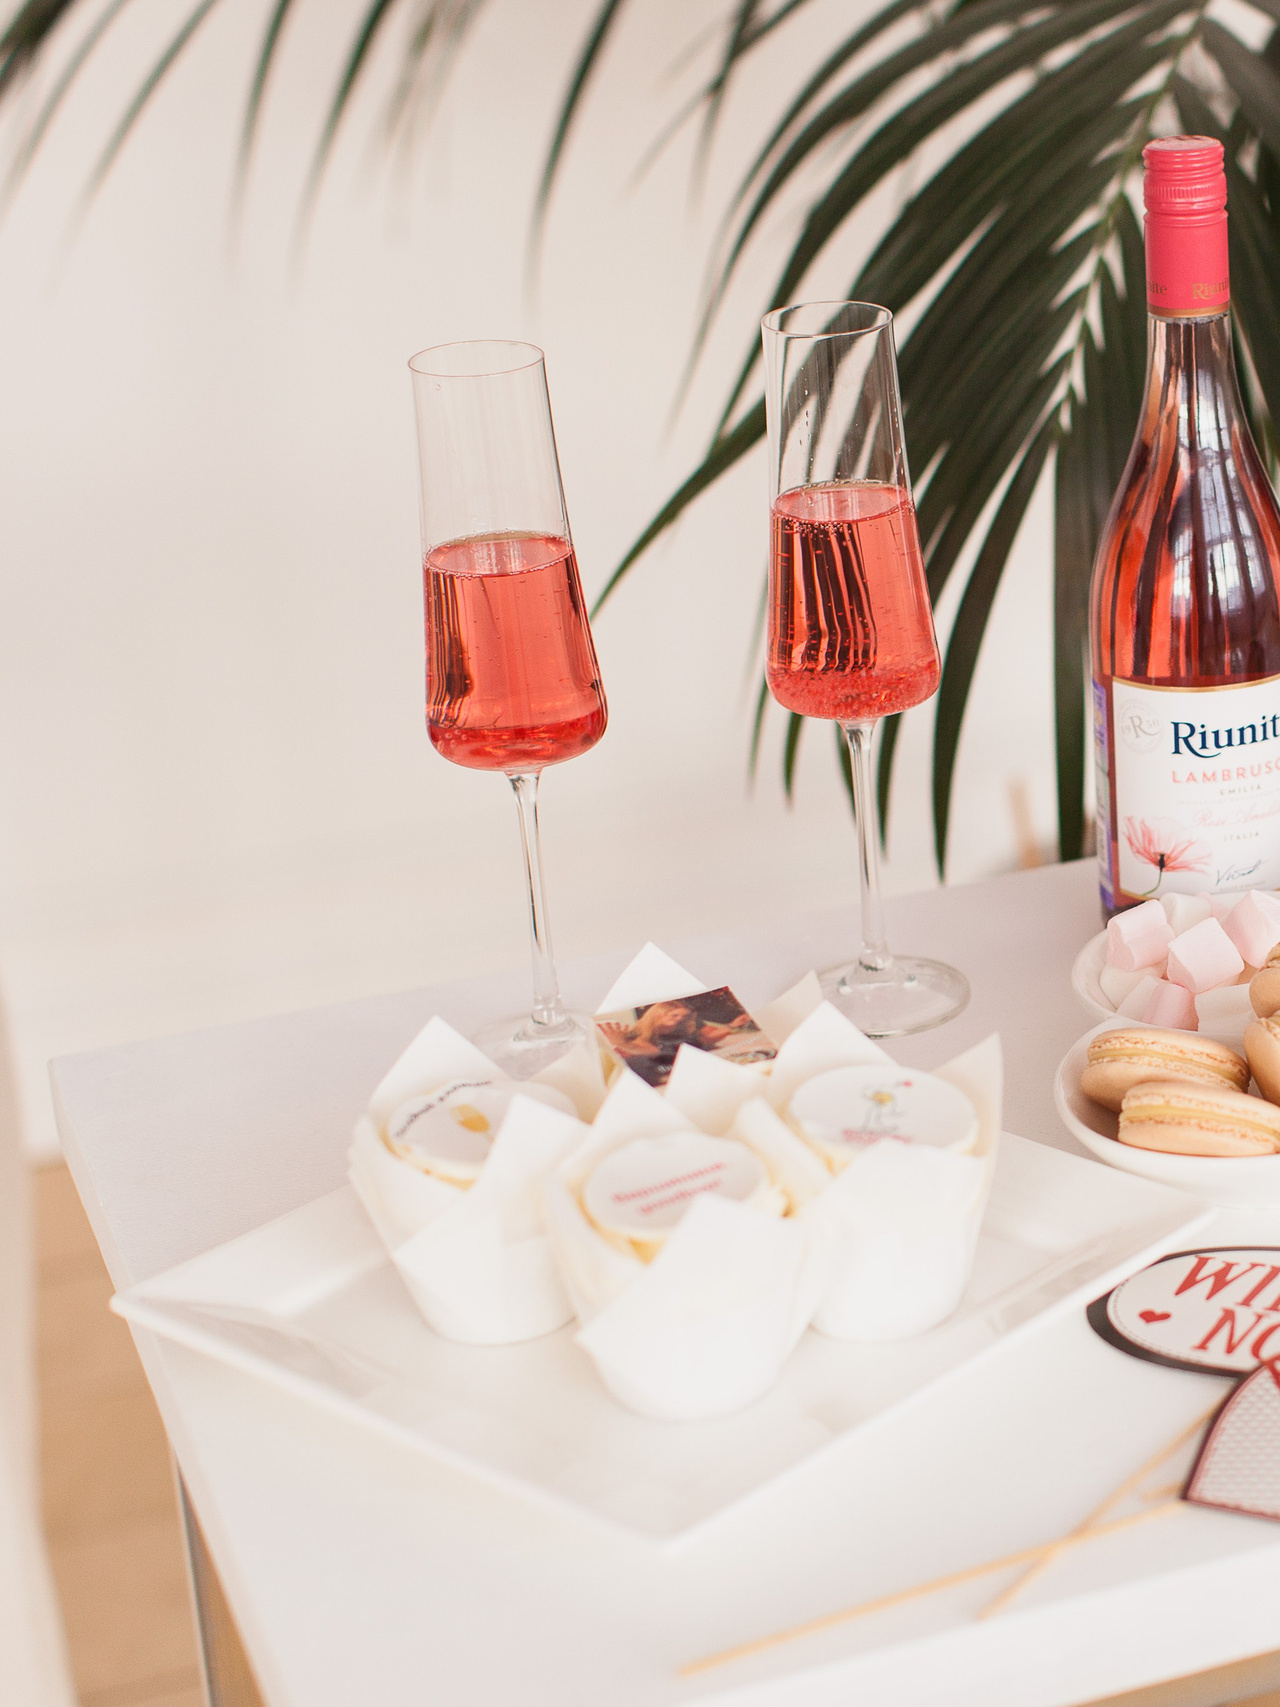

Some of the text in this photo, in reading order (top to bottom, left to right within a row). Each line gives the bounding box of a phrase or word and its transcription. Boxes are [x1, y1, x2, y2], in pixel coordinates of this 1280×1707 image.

[1192, 277, 1230, 300] Riuni
[1220, 784, 1262, 796] EMILIA
[1223, 831, 1261, 842] ITALIA
